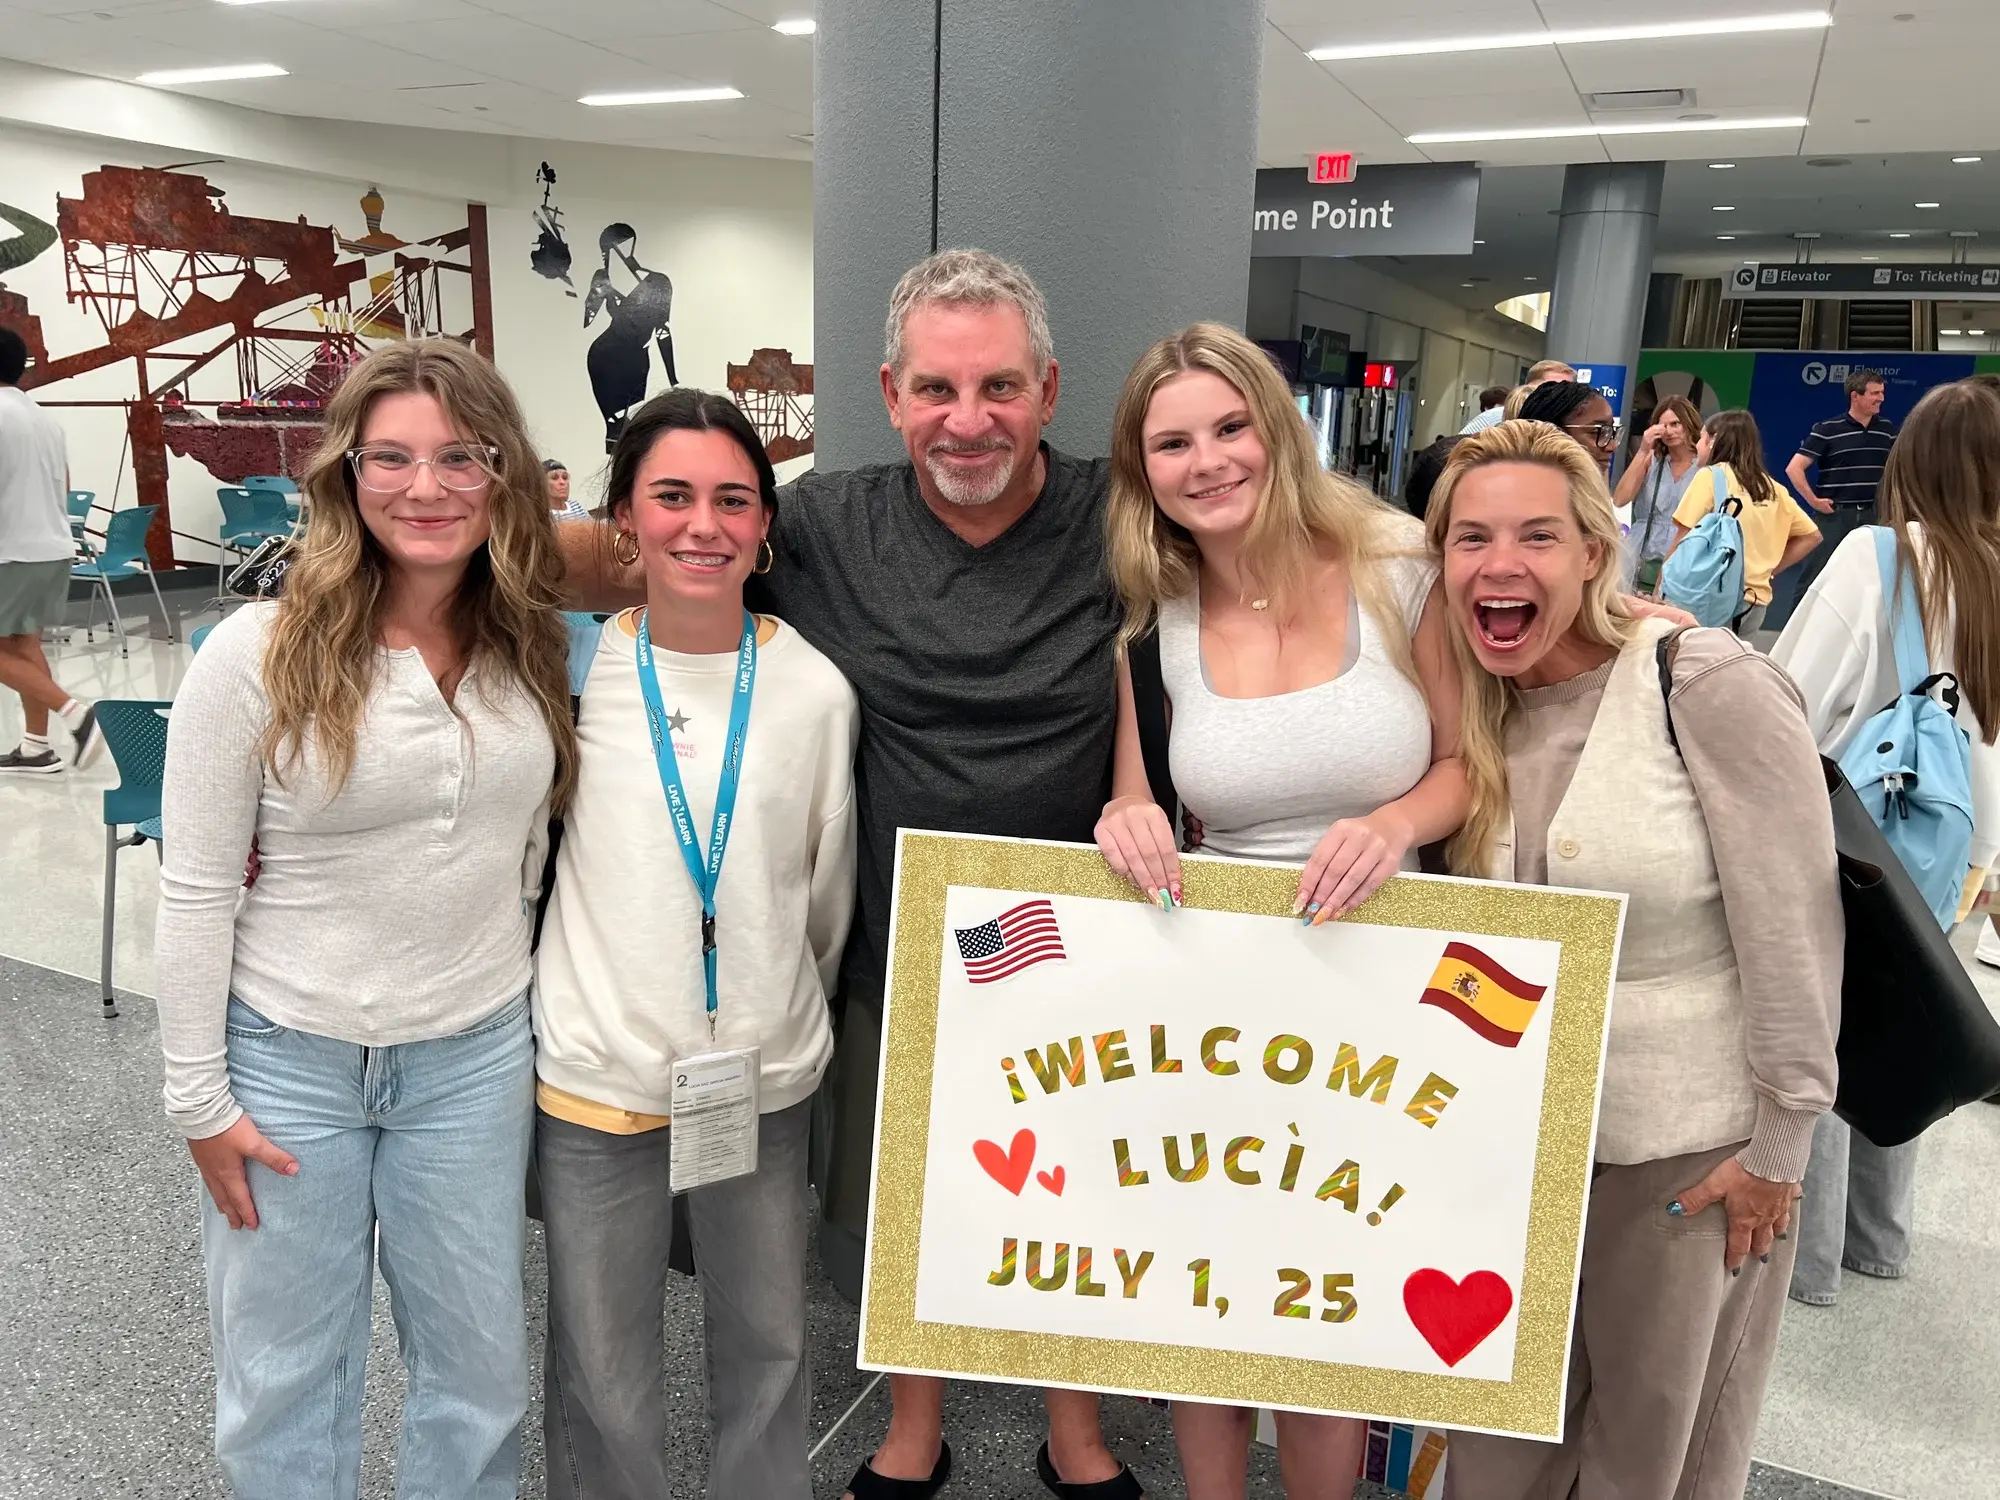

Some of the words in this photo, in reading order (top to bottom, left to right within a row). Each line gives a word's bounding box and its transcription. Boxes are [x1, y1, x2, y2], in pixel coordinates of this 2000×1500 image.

[1316, 153, 1352, 180] EXIT
[1253, 208, 1298, 231] me
[1311, 198, 1394, 230] Point
[1780, 269, 1832, 282] Elevator
[1895, 270, 1914, 283] To:
[1919, 270, 1979, 286] Ticketing
[1601, 385, 1618, 398] To:
[638, 633, 649, 667] LEARN
[743, 633, 754, 665] LEARN
[739, 671, 751, 694] LIVE
[667, 784, 682, 807] LIVE
[676, 812, 693, 846] LEARN
[714, 812, 728, 846] LEARN
[710, 852, 721, 874] LIVE
[676, 1074, 688, 1088] 2
[987, 1237, 1155, 1299] JULY
[1187, 1258, 1229, 1319] 1,
[1273, 1267, 1358, 1324] 25
